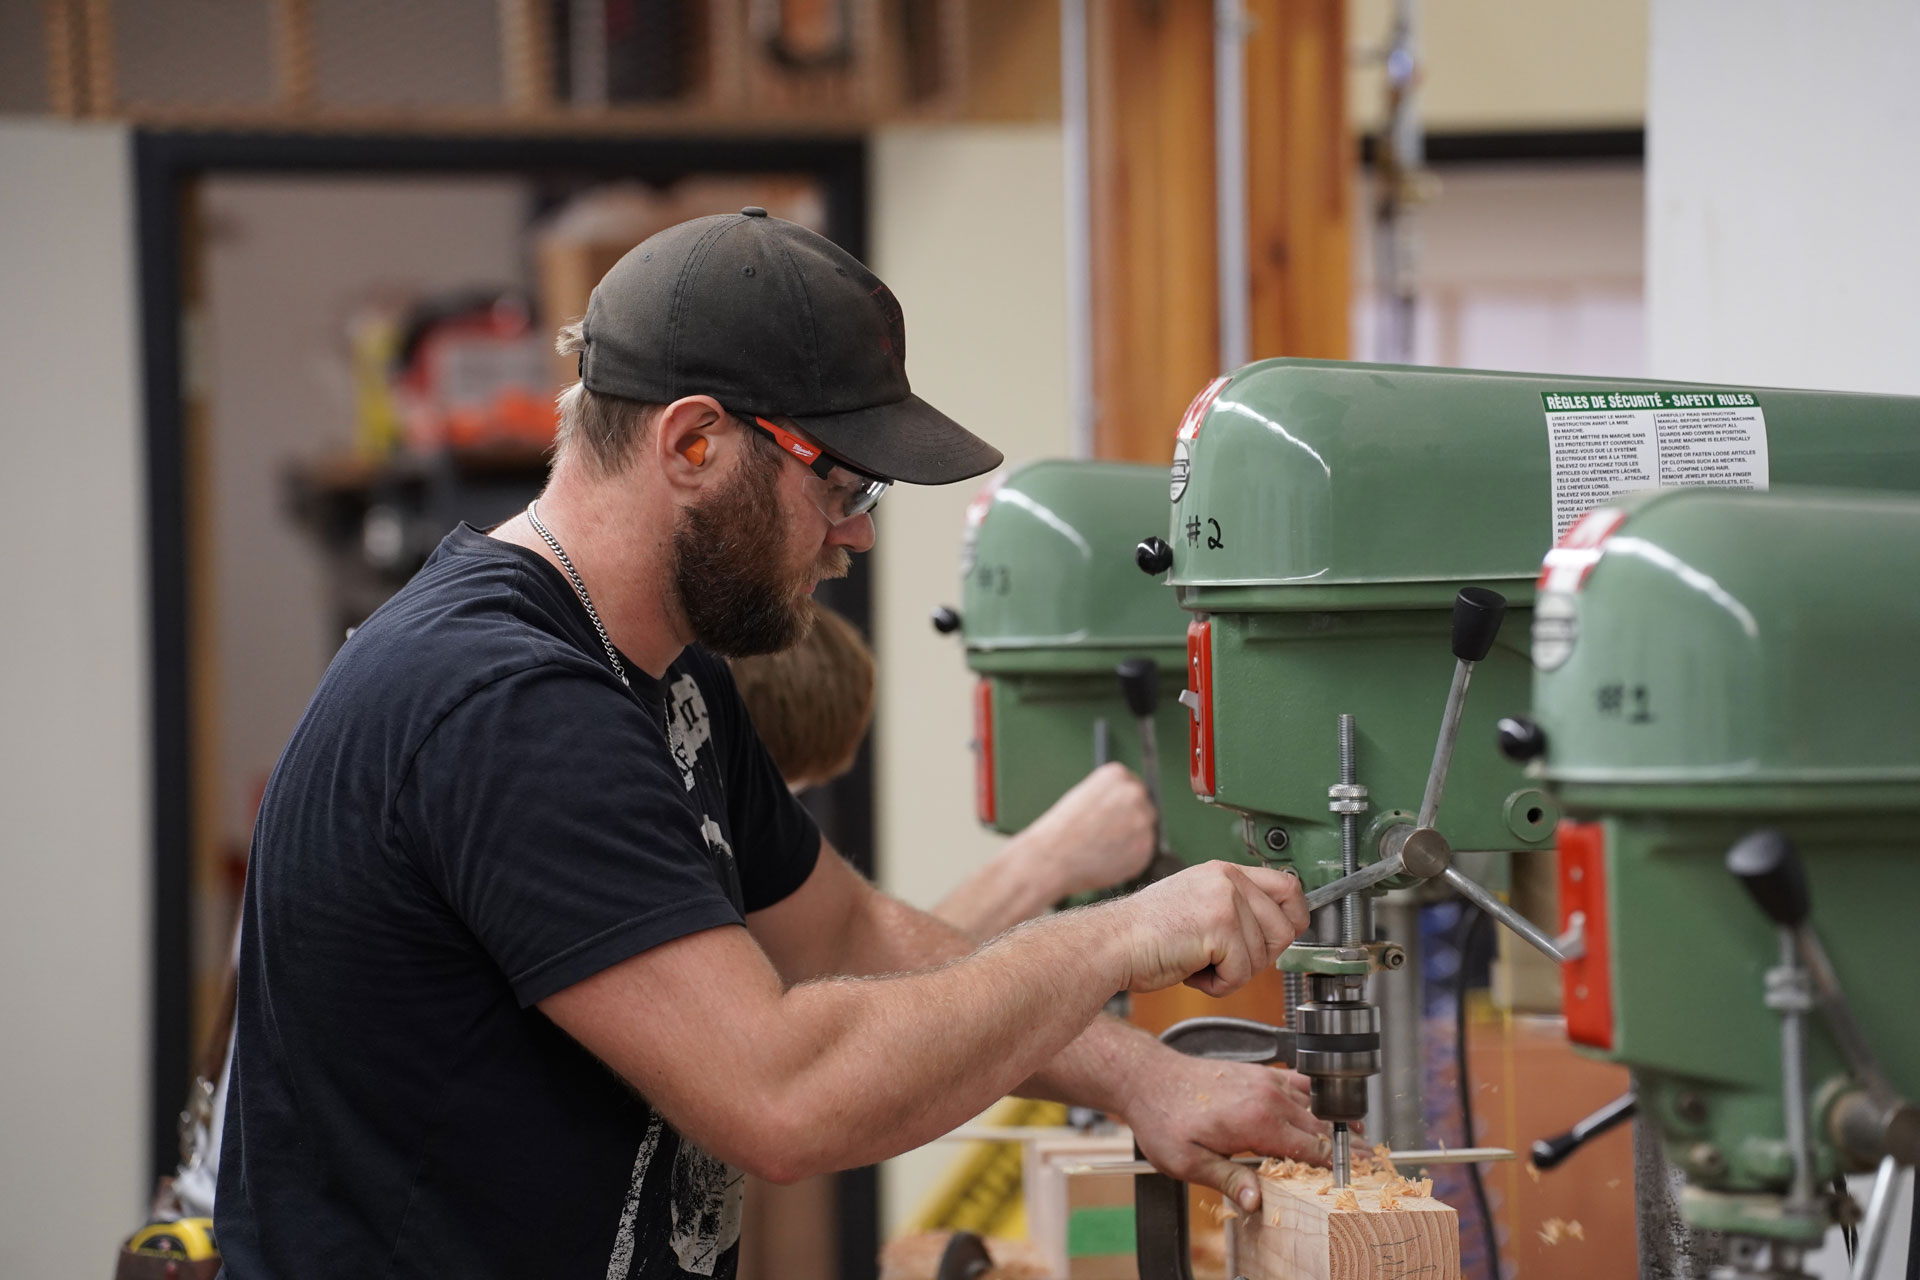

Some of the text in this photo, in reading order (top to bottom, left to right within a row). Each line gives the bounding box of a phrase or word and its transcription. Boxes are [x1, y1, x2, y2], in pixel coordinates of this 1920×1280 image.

[1546, 393, 1589, 409] RÈGLES
[1590, 396, 1607, 408] DE
[1608, 392, 1663, 408] SÉCURITÉ
[1672, 394, 1714, 407] SAFETY
[1717, 394, 1754, 405] RULES
[1186, 515, 1224, 550] #2
